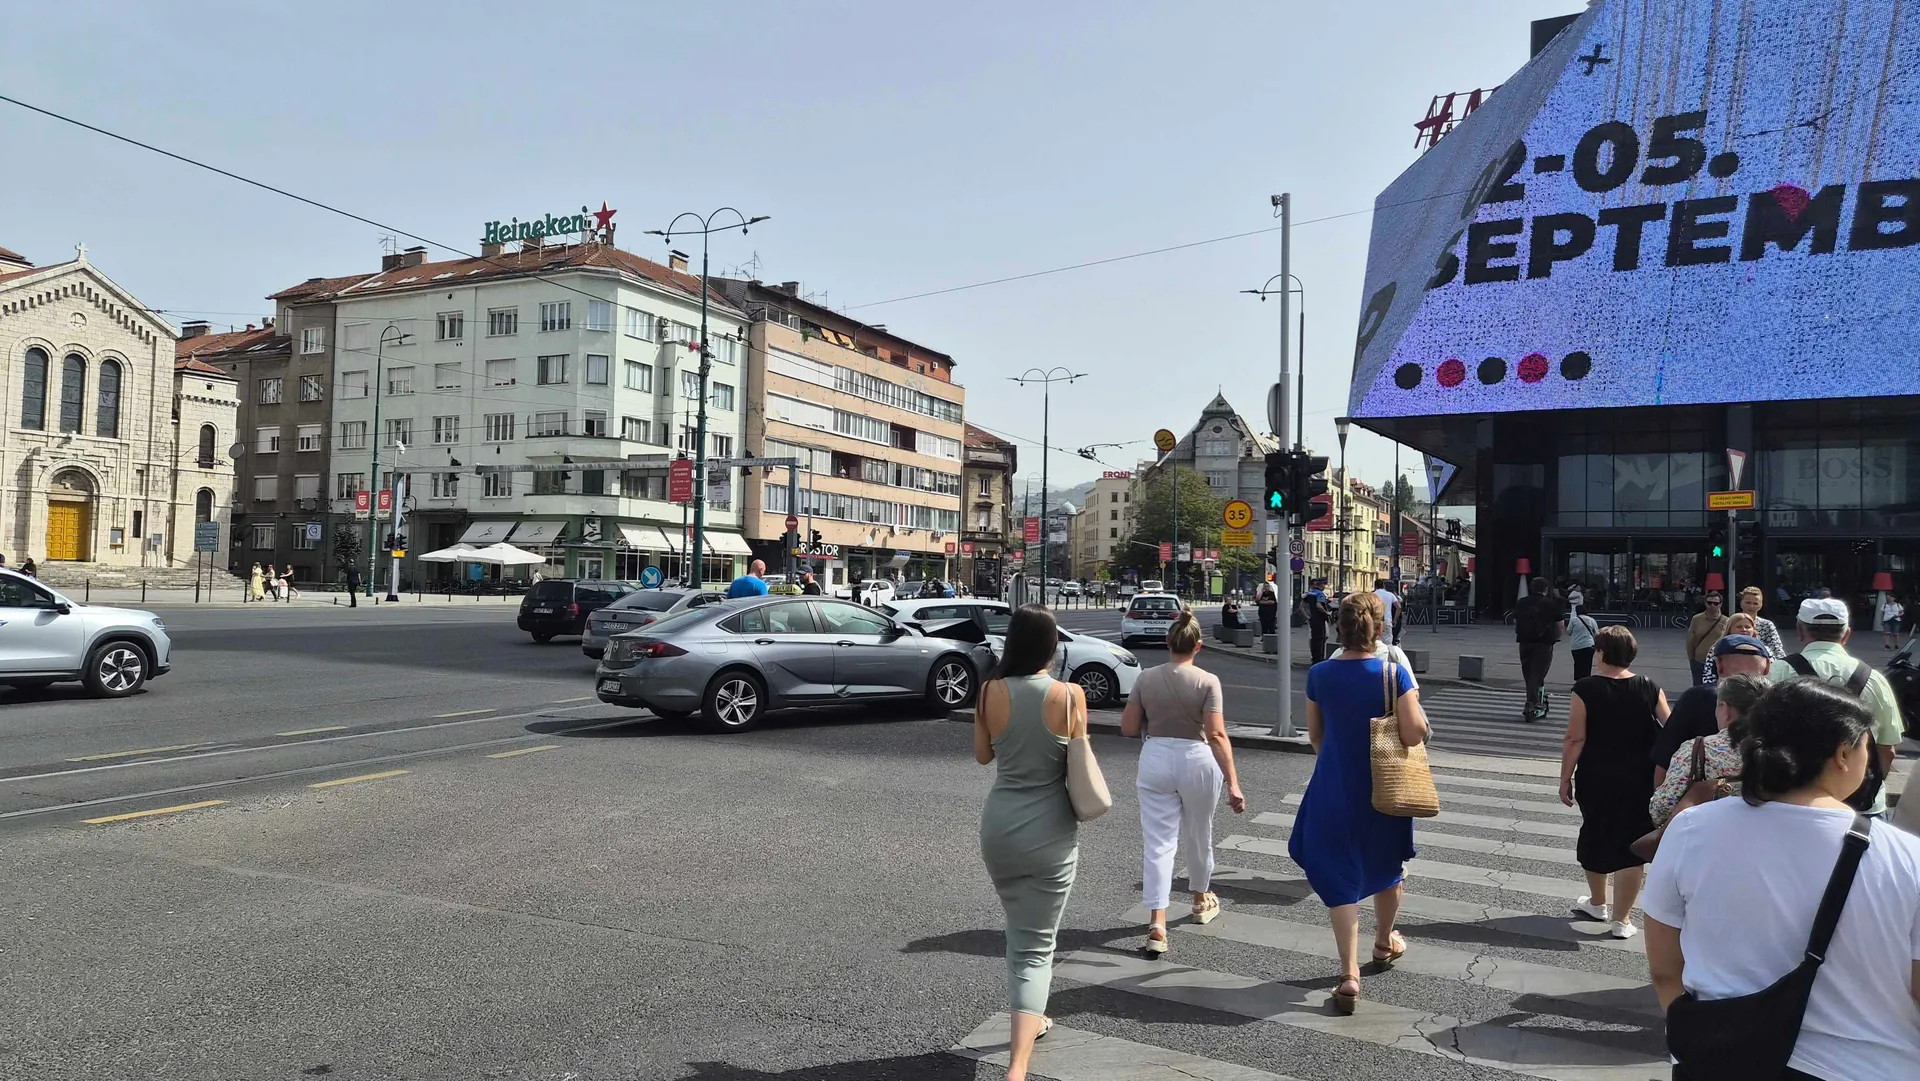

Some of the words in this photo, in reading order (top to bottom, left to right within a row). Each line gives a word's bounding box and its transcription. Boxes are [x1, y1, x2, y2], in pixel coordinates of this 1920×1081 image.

[485, 213, 586, 245] Heineken
[1797, 457, 1892, 479] BOSS
[798, 542, 839, 557] RSTOR
[1291, 543, 1302, 552] 60
